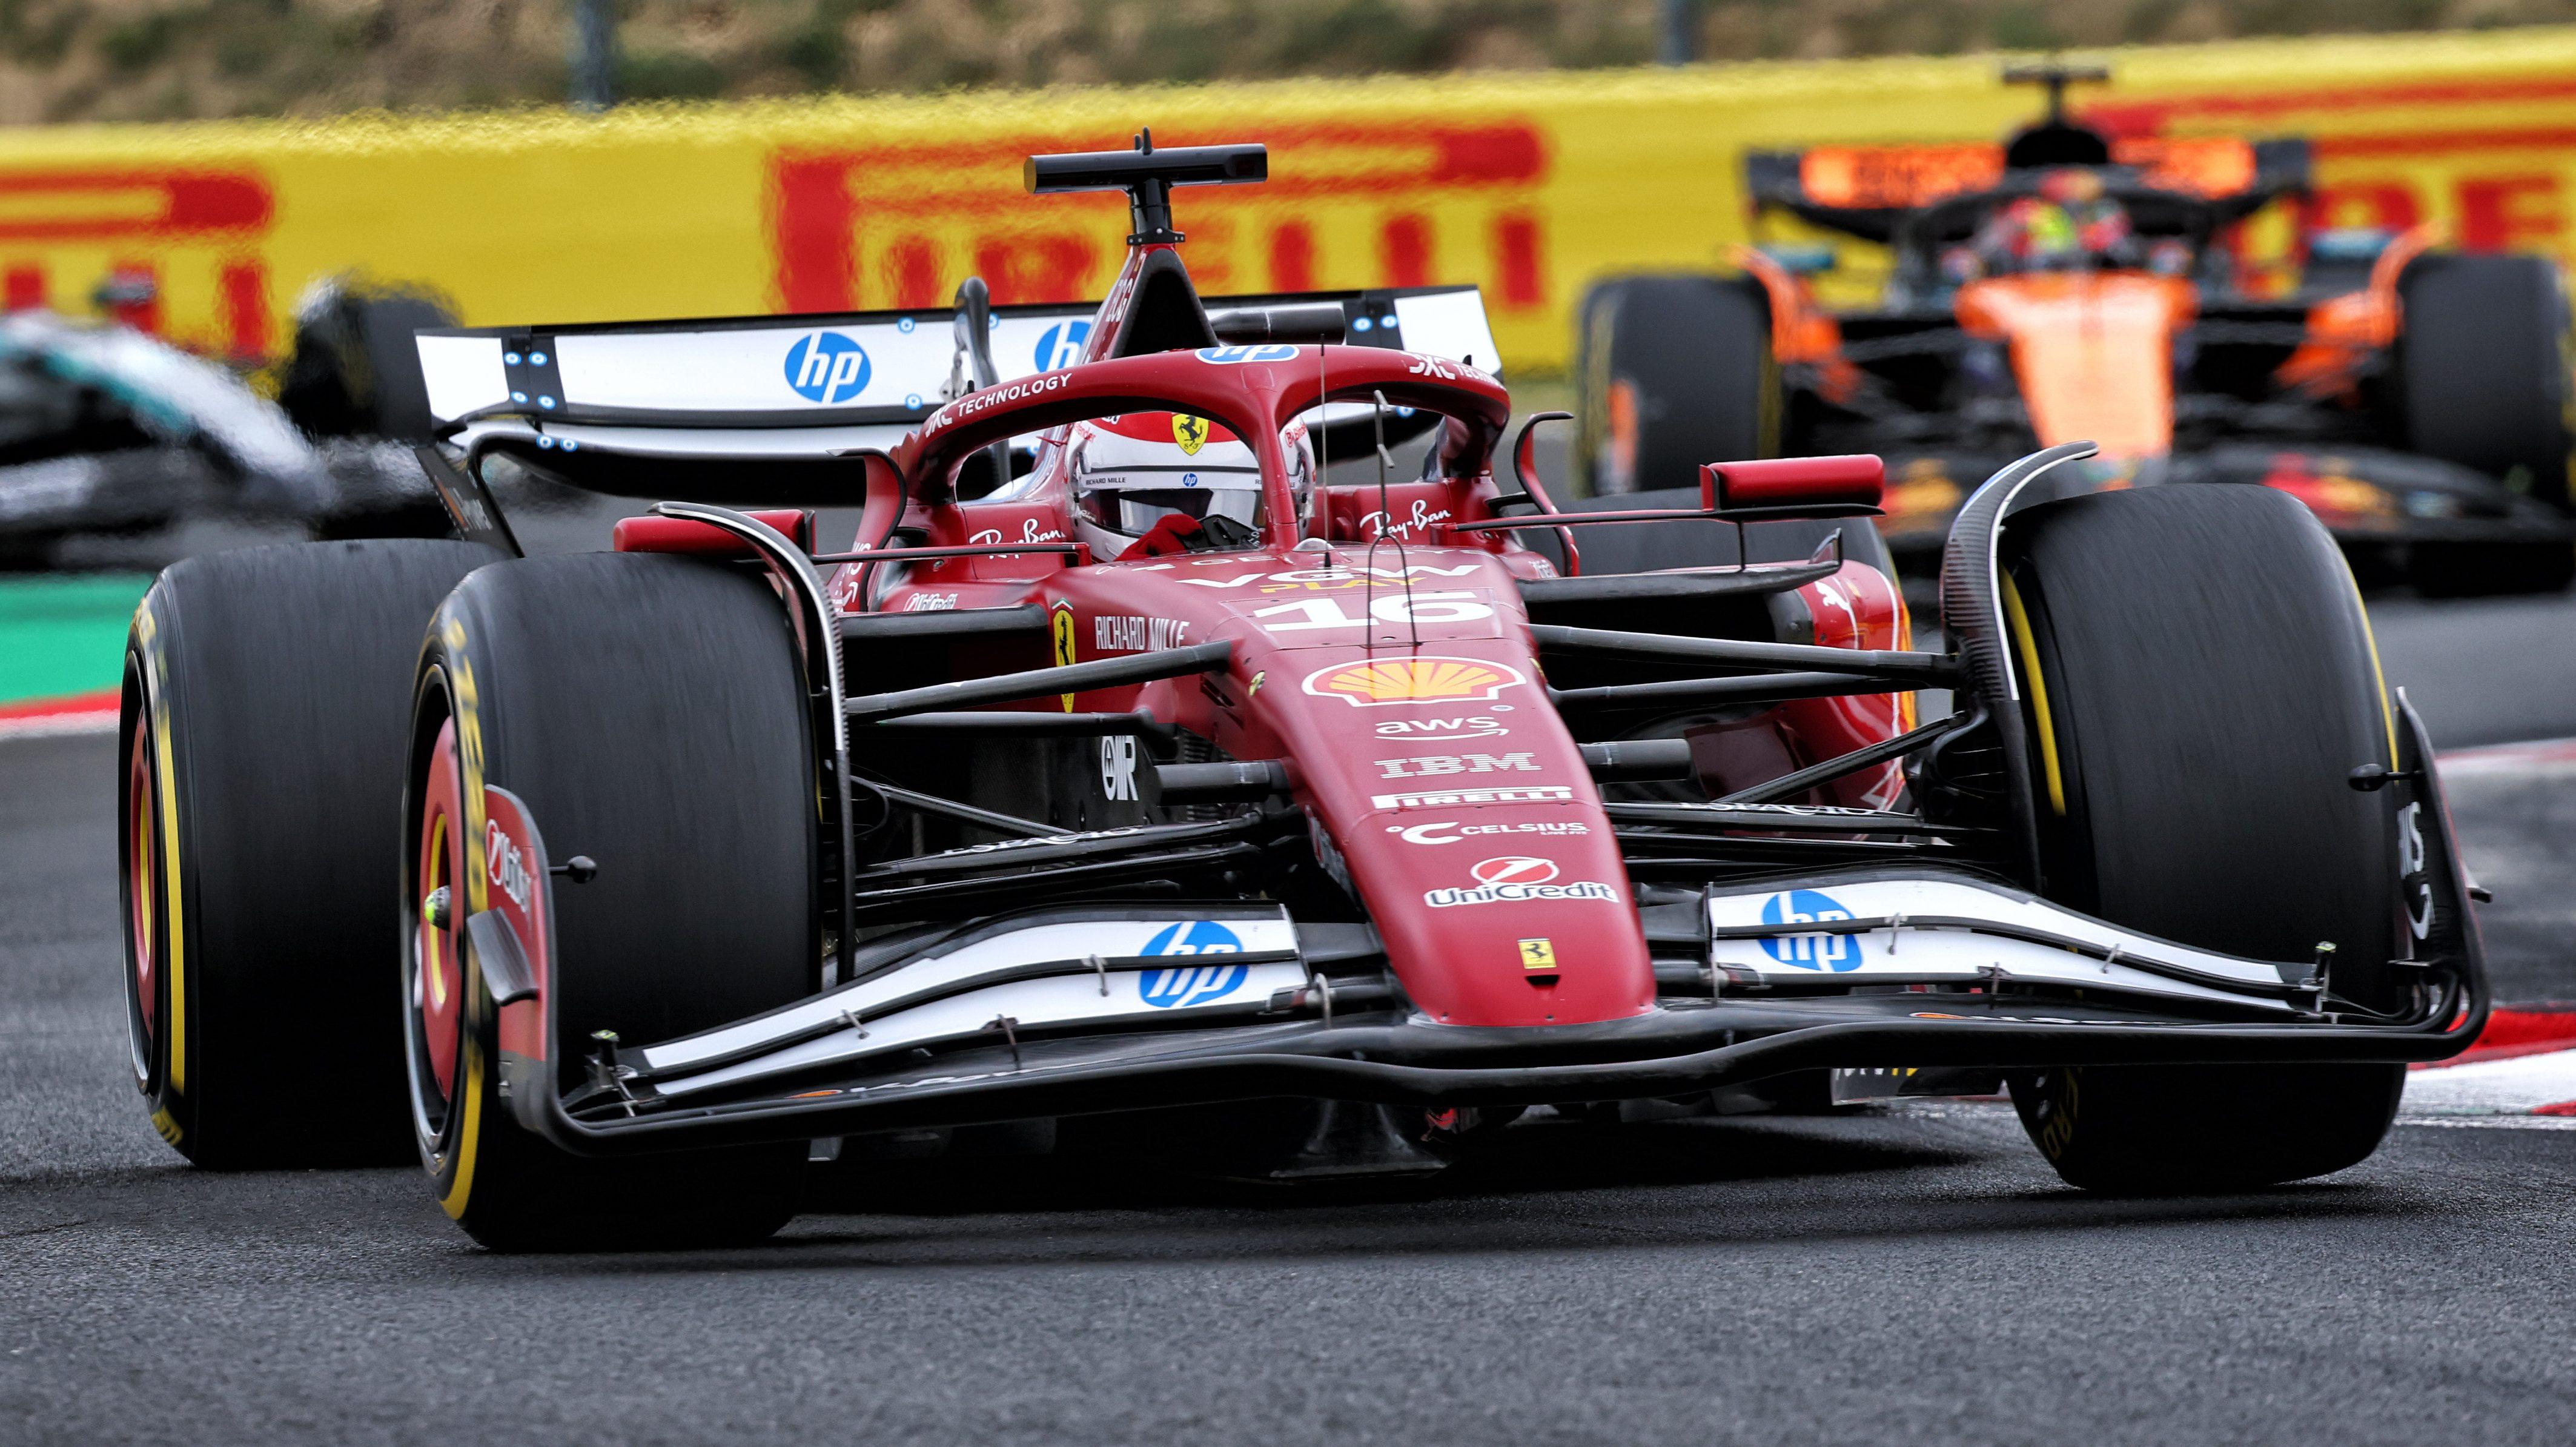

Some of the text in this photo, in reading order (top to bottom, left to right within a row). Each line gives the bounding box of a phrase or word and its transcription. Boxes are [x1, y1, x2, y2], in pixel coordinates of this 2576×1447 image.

[795, 332, 863, 405] hp
[958, 373, 1073, 417] TECHNOLOGY
[1184, 473, 1197, 487] hp
[1360, 500, 1452, 541] Ray-Ban
[1175, 565, 1483, 588] VGW
[1258, 577, 1426, 594] PLAY
[1253, 591, 1494, 632] 16
[1094, 616, 1190, 651] RICHARD MILLE
[1375, 717, 1500, 735] aws
[1373, 752, 1543, 779] IBM
[1371, 786, 1574, 809] PIRELLI
[1428, 882, 1617, 907] UniCredit
[1775, 891, 1849, 973] hp
[1146, 921, 1240, 1008] hp
